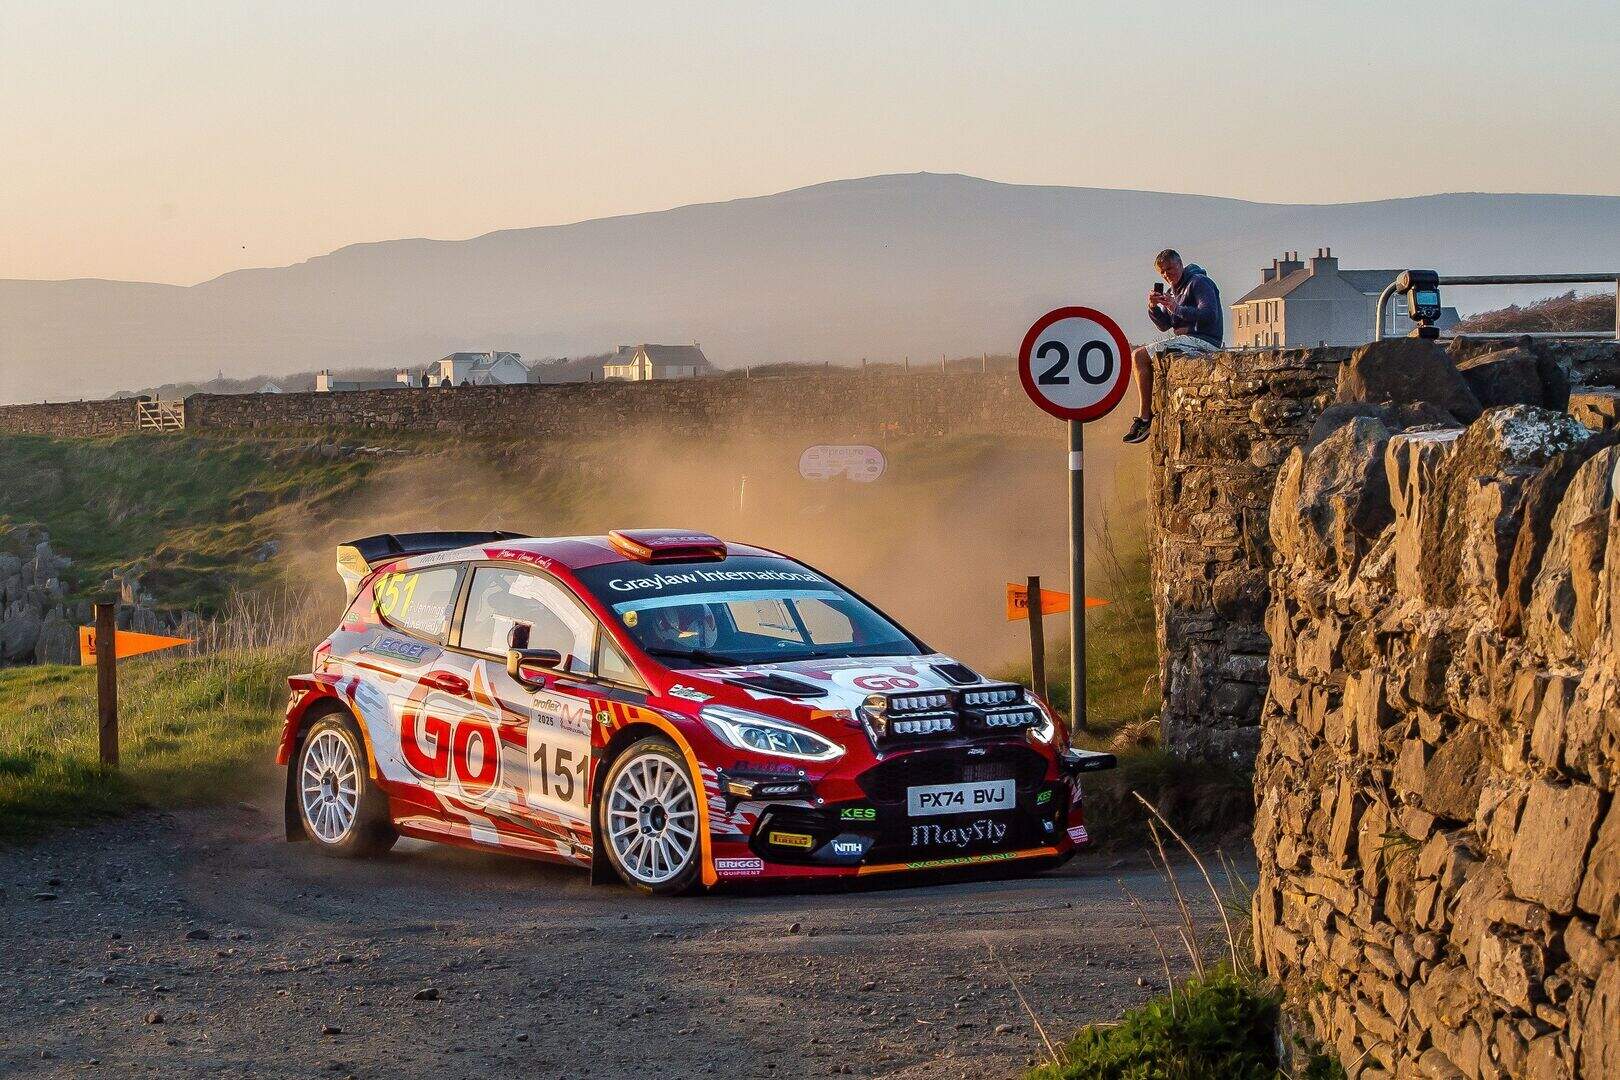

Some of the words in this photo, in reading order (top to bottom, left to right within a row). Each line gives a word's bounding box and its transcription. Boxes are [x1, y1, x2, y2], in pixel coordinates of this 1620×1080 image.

[1035, 340, 1115, 386] 20
[608, 573, 698, 592] Graylaw
[699, 569, 823, 583] International
[369, 572, 420, 618] 151
[537, 714, 554, 726] 2025
[533, 742, 590, 809] 151
[919, 790, 965, 808] PX74
[973, 787, 1005, 804] BVJ
[1037, 790, 1053, 803] KES
[840, 808, 877, 818] KES
[718, 859, 761, 868] BRIGGS
[905, 852, 1018, 870] WOODLAND
